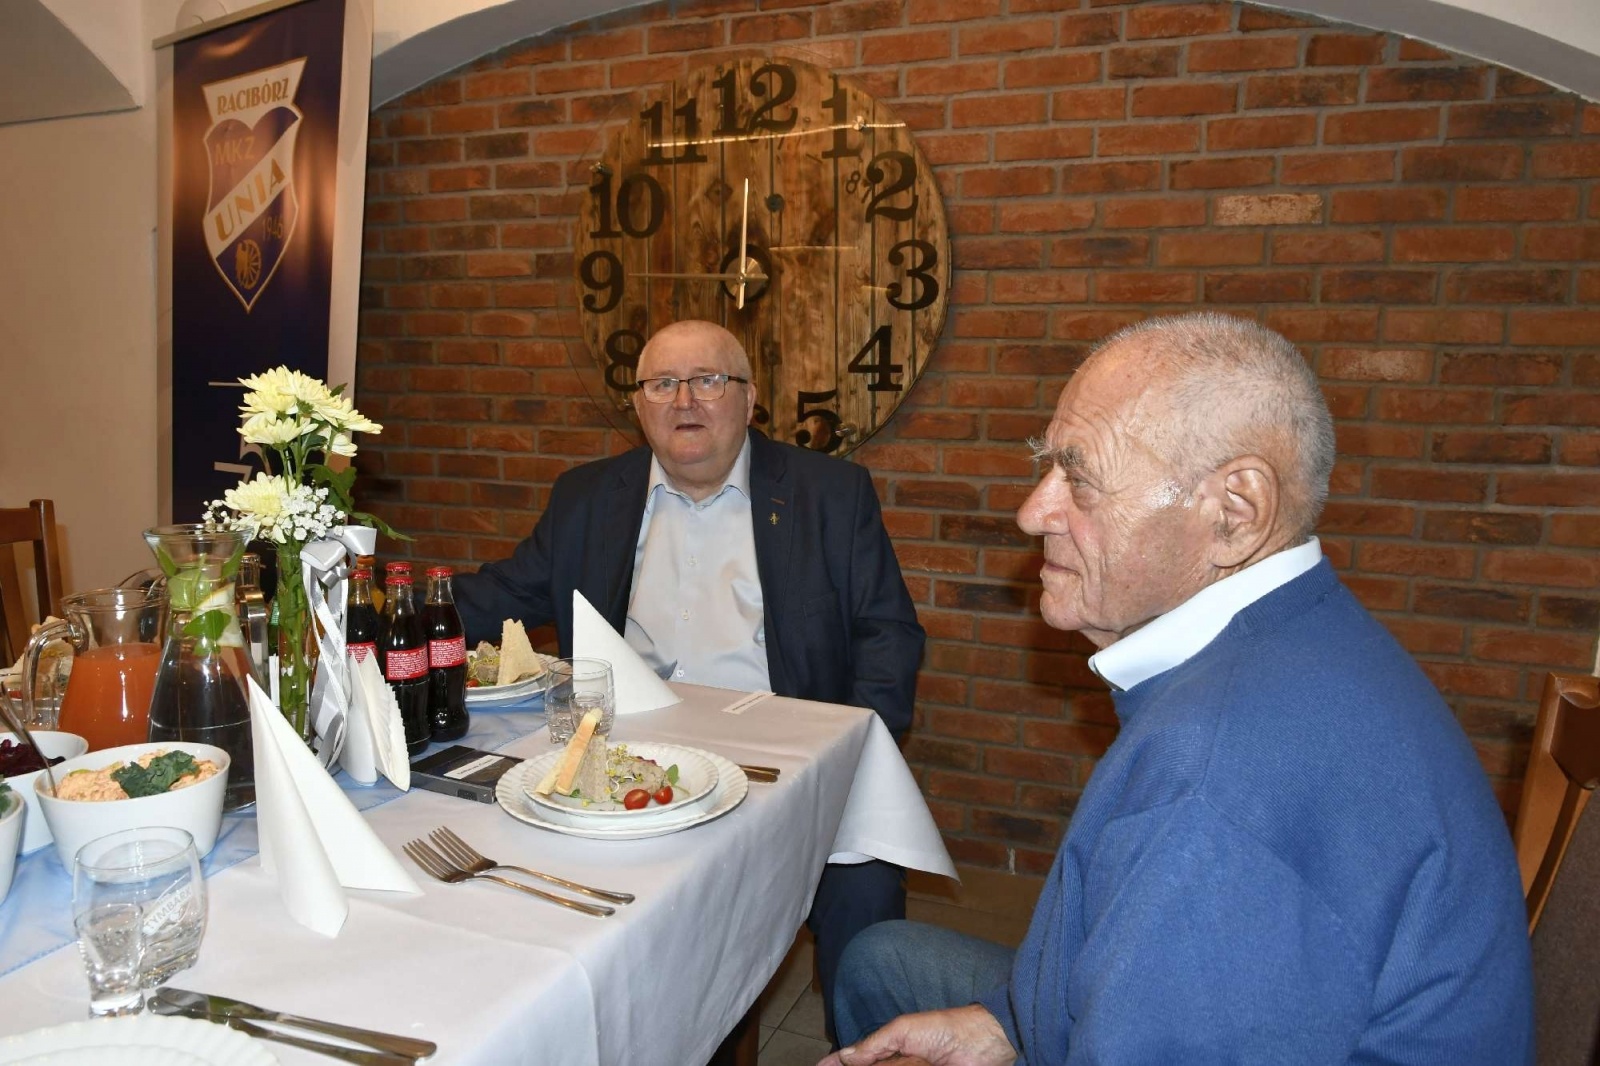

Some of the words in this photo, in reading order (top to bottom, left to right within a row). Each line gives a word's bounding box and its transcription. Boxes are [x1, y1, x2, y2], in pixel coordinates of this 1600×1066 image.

[640, 97, 708, 167] 11
[711, 64, 799, 137] 12
[821, 87, 862, 159] 1
[215, 136, 257, 166] MKZ
[214, 157, 286, 243] UNIA
[588, 172, 666, 240] 10
[865, 150, 919, 223] 2
[579, 250, 625, 314] 9
[886, 239, 940, 311] 3
[604, 329, 647, 393] 8
[847, 324, 904, 392] 4
[795, 387, 843, 454] 5
